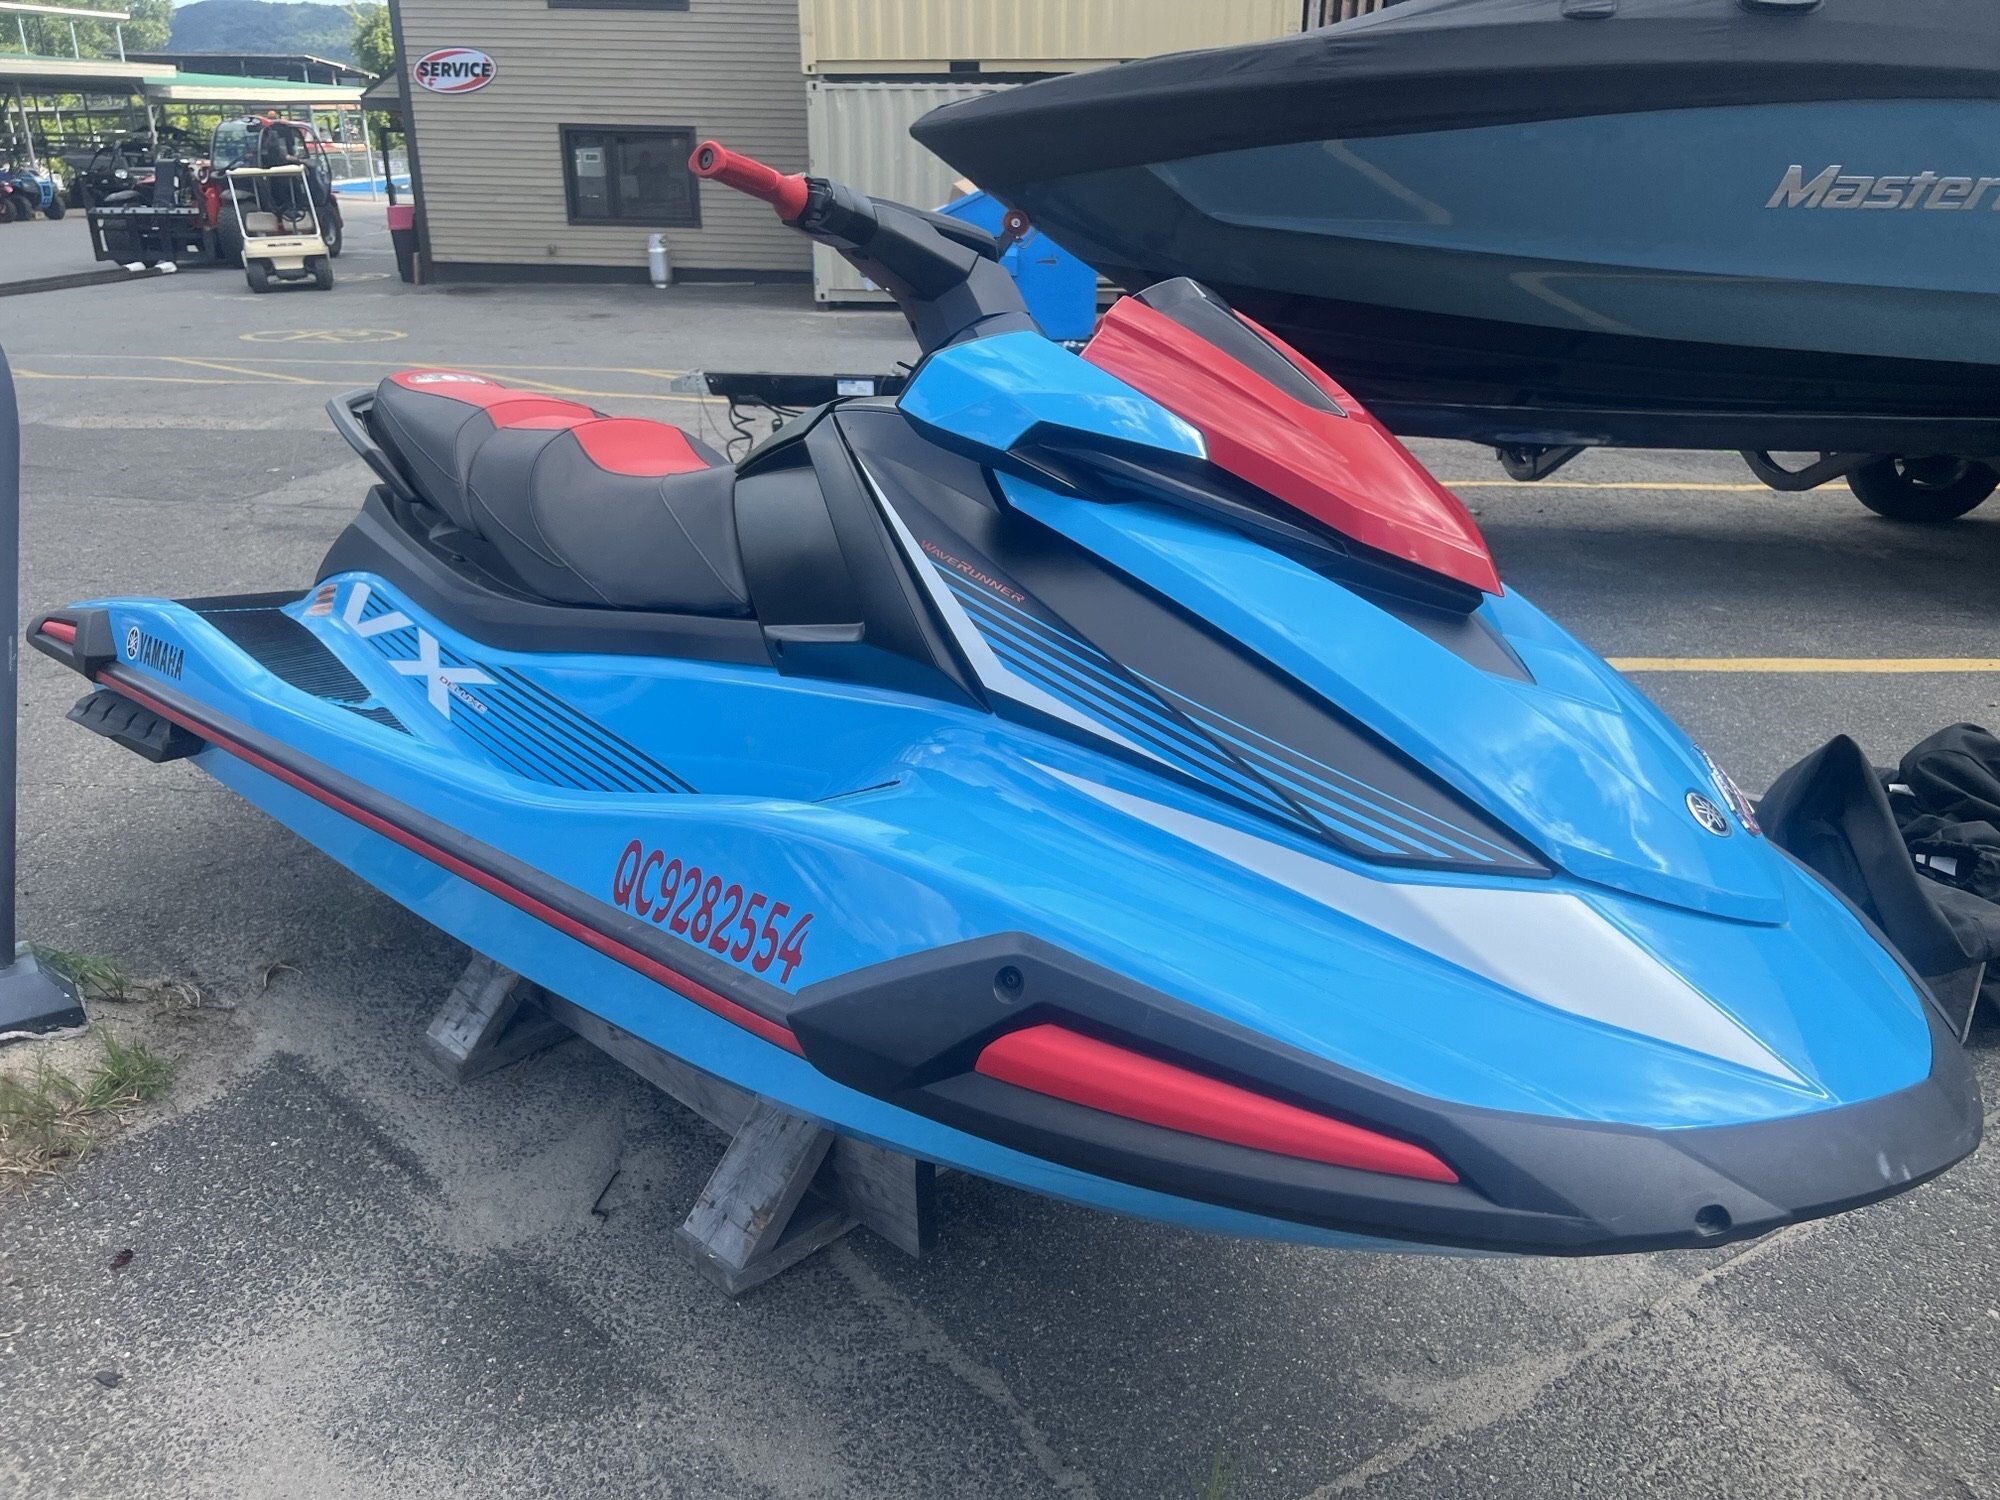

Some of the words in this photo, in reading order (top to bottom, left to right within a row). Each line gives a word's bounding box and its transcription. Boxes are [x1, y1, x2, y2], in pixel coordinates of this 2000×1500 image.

[420, 61, 492, 78] SERVICE
[1765, 164, 2000, 211] Master
[139, 632, 185, 681] YAMAHA
[343, 582, 499, 720] VX
[439, 675, 488, 713] DELUXE
[613, 839, 814, 984] QC9282554
